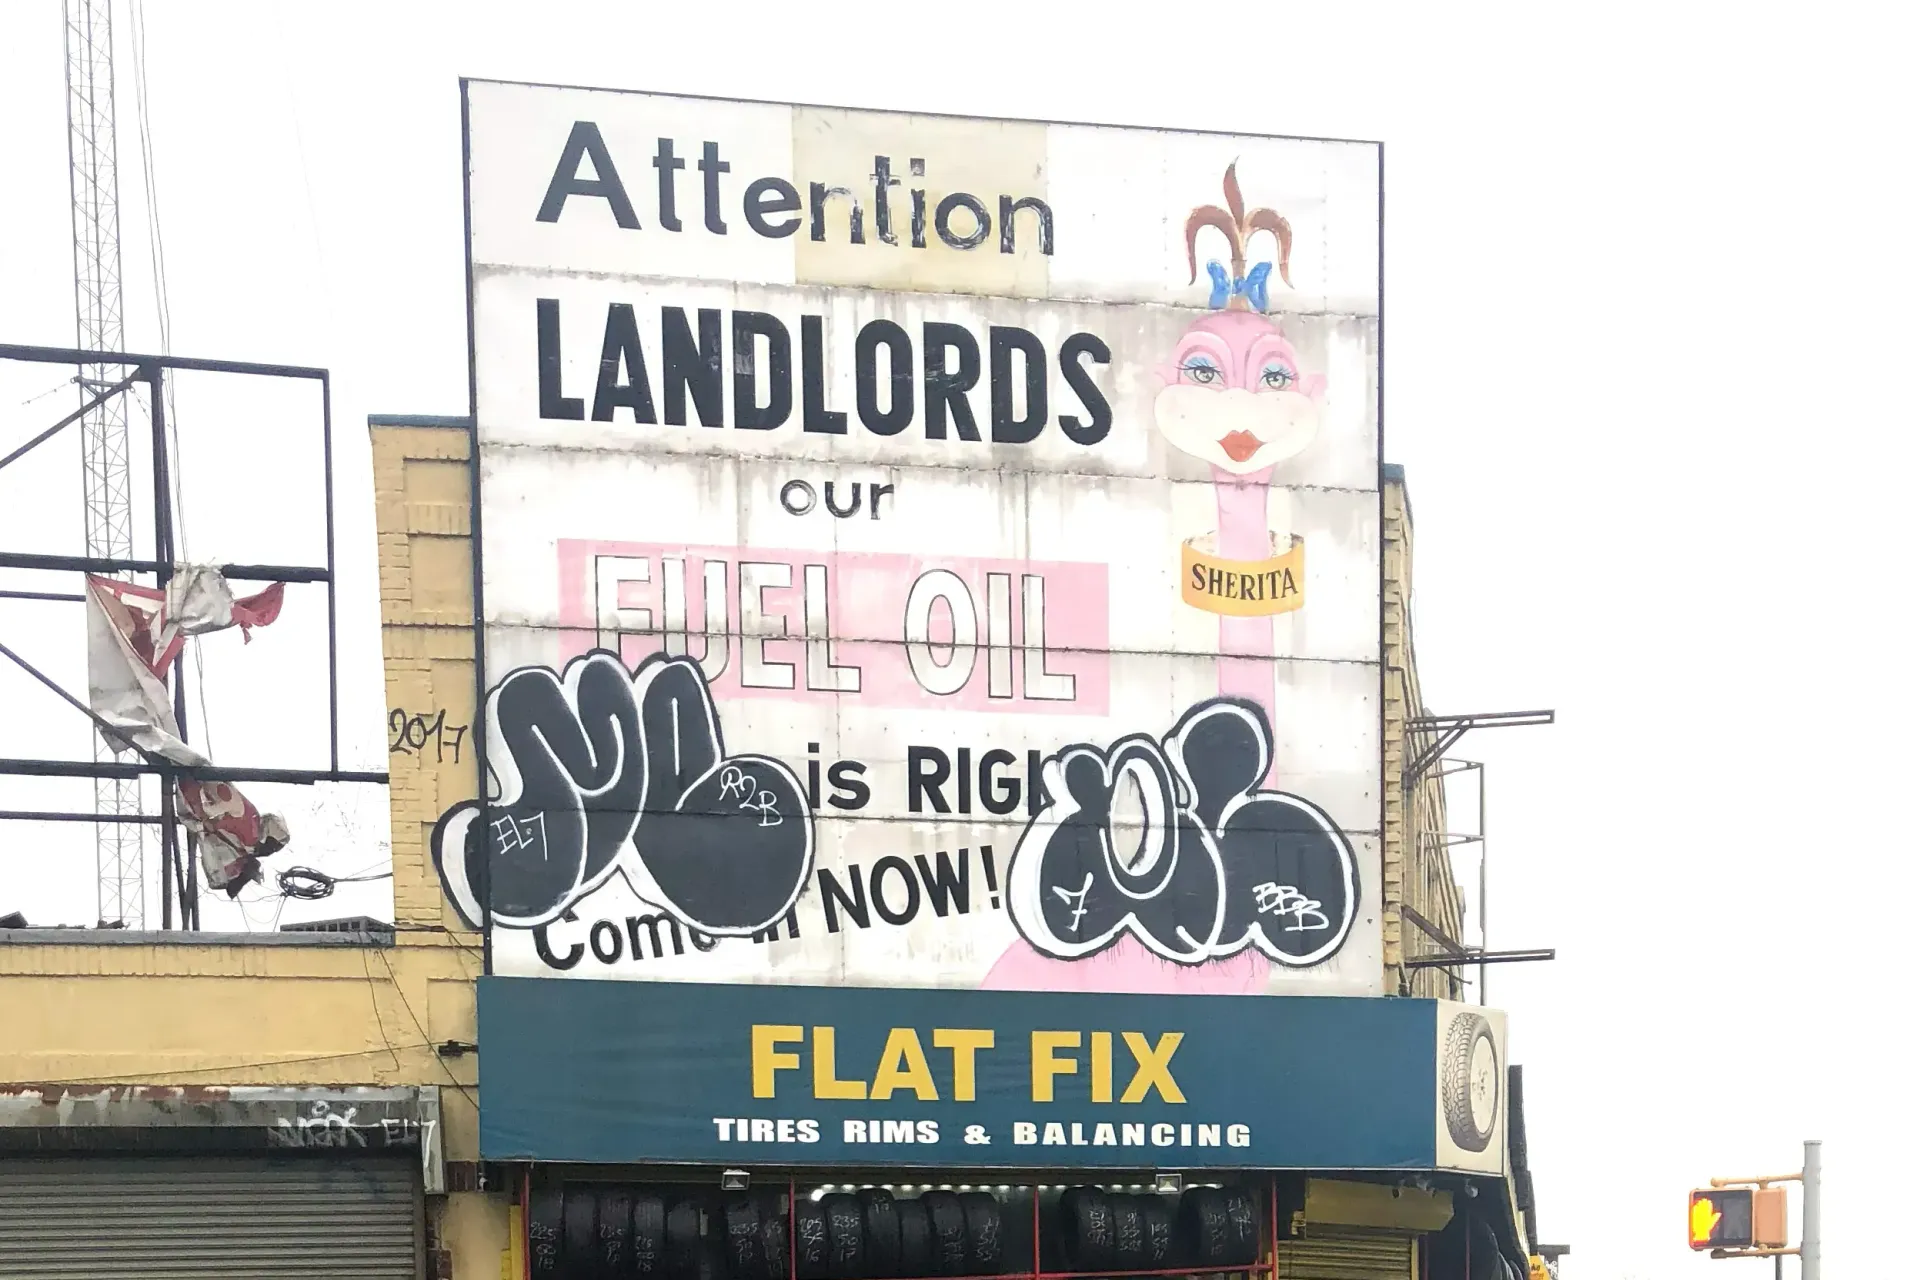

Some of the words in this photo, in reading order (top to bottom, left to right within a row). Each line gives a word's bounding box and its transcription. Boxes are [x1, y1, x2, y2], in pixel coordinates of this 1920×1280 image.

[536, 121, 1055, 256] Attention
[537, 298, 1113, 446] LANDLORDS
[780, 479, 895, 520] our
[1192, 563, 1299, 602] SHERITA
[595, 555, 862, 693] FUEL
[904, 568, 1077, 701] OIL
[389, 708, 468, 764] 2017
[808, 742, 871, 811] is
[817, 845, 1000, 933] NOW!
[752, 1024, 996, 1102] FLAT
[1031, 1031, 1188, 1104] FIX
[713, 1118, 821, 1144] TIRES
[843, 1119, 941, 1145] RIMS
[964, 1124, 992, 1146] &
[1013, 1121, 1252, 1148] BALANCING
[832, 1215, 860, 1228] 235
